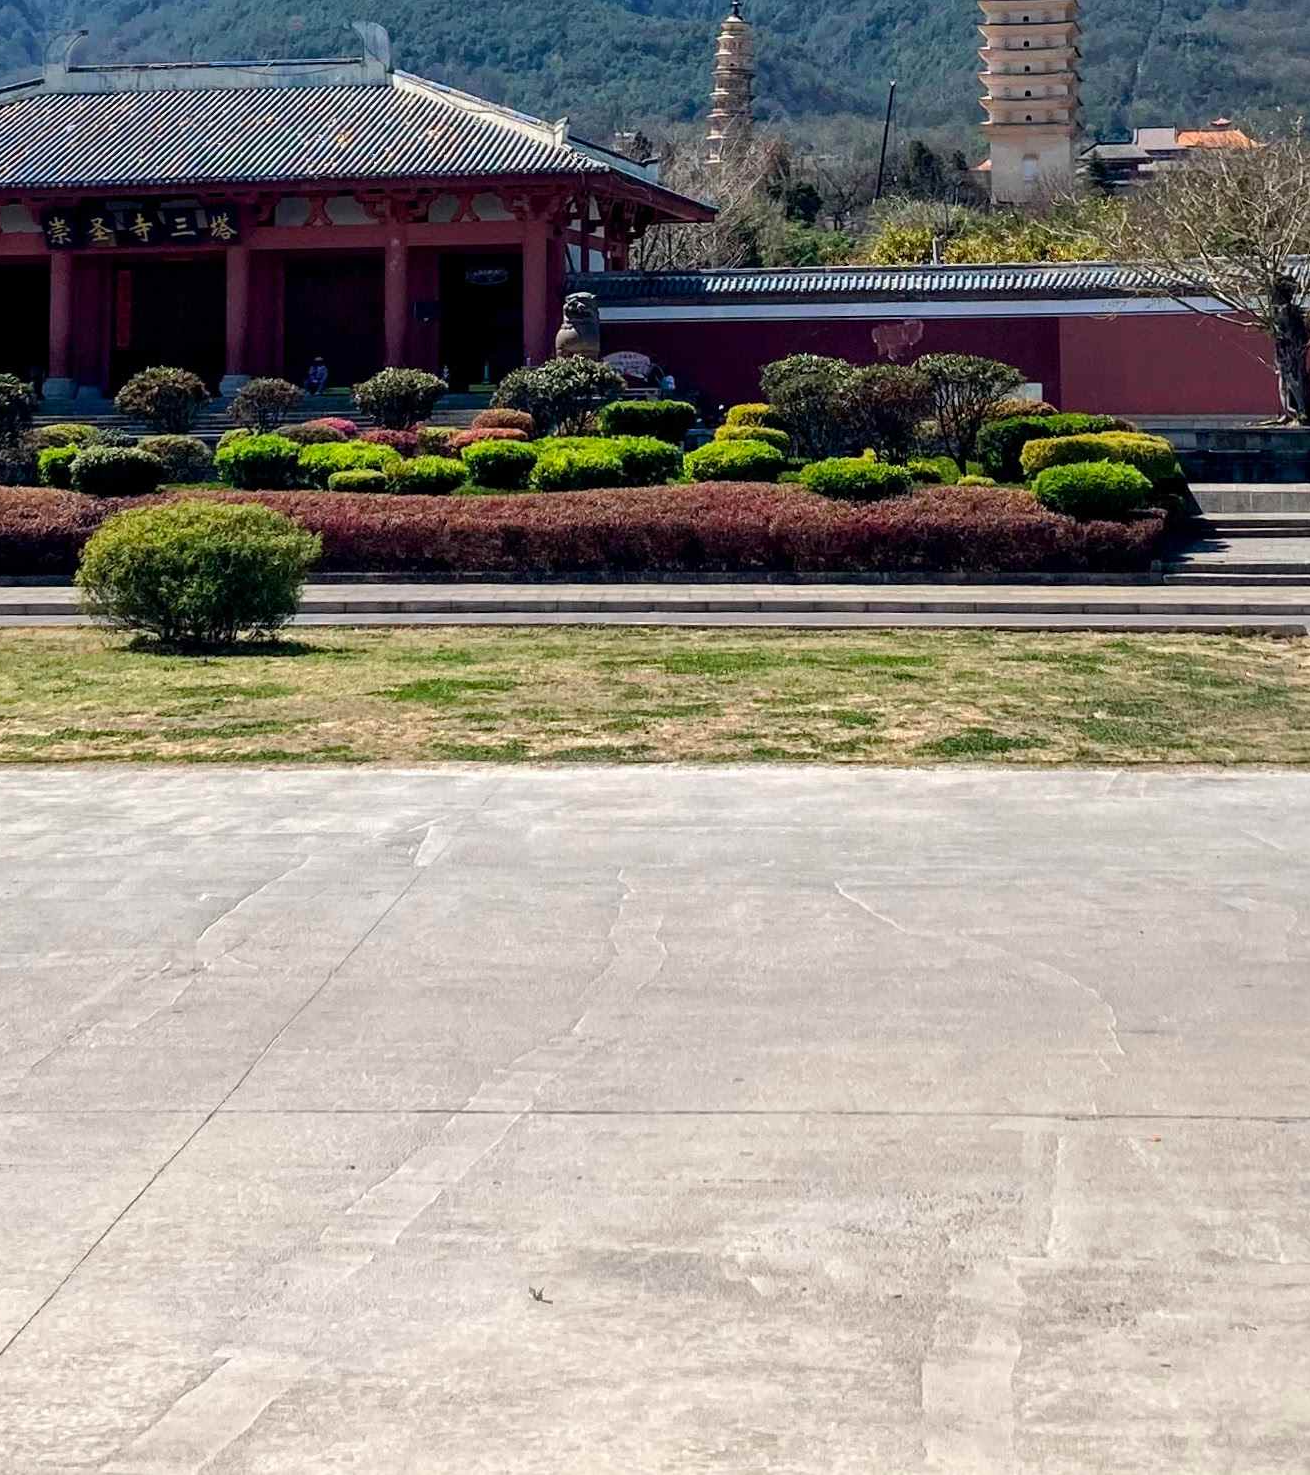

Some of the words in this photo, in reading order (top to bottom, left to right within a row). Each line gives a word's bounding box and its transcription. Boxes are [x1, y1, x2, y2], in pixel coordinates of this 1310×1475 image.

[47, 212, 238, 244] 崇圣寺三塔
